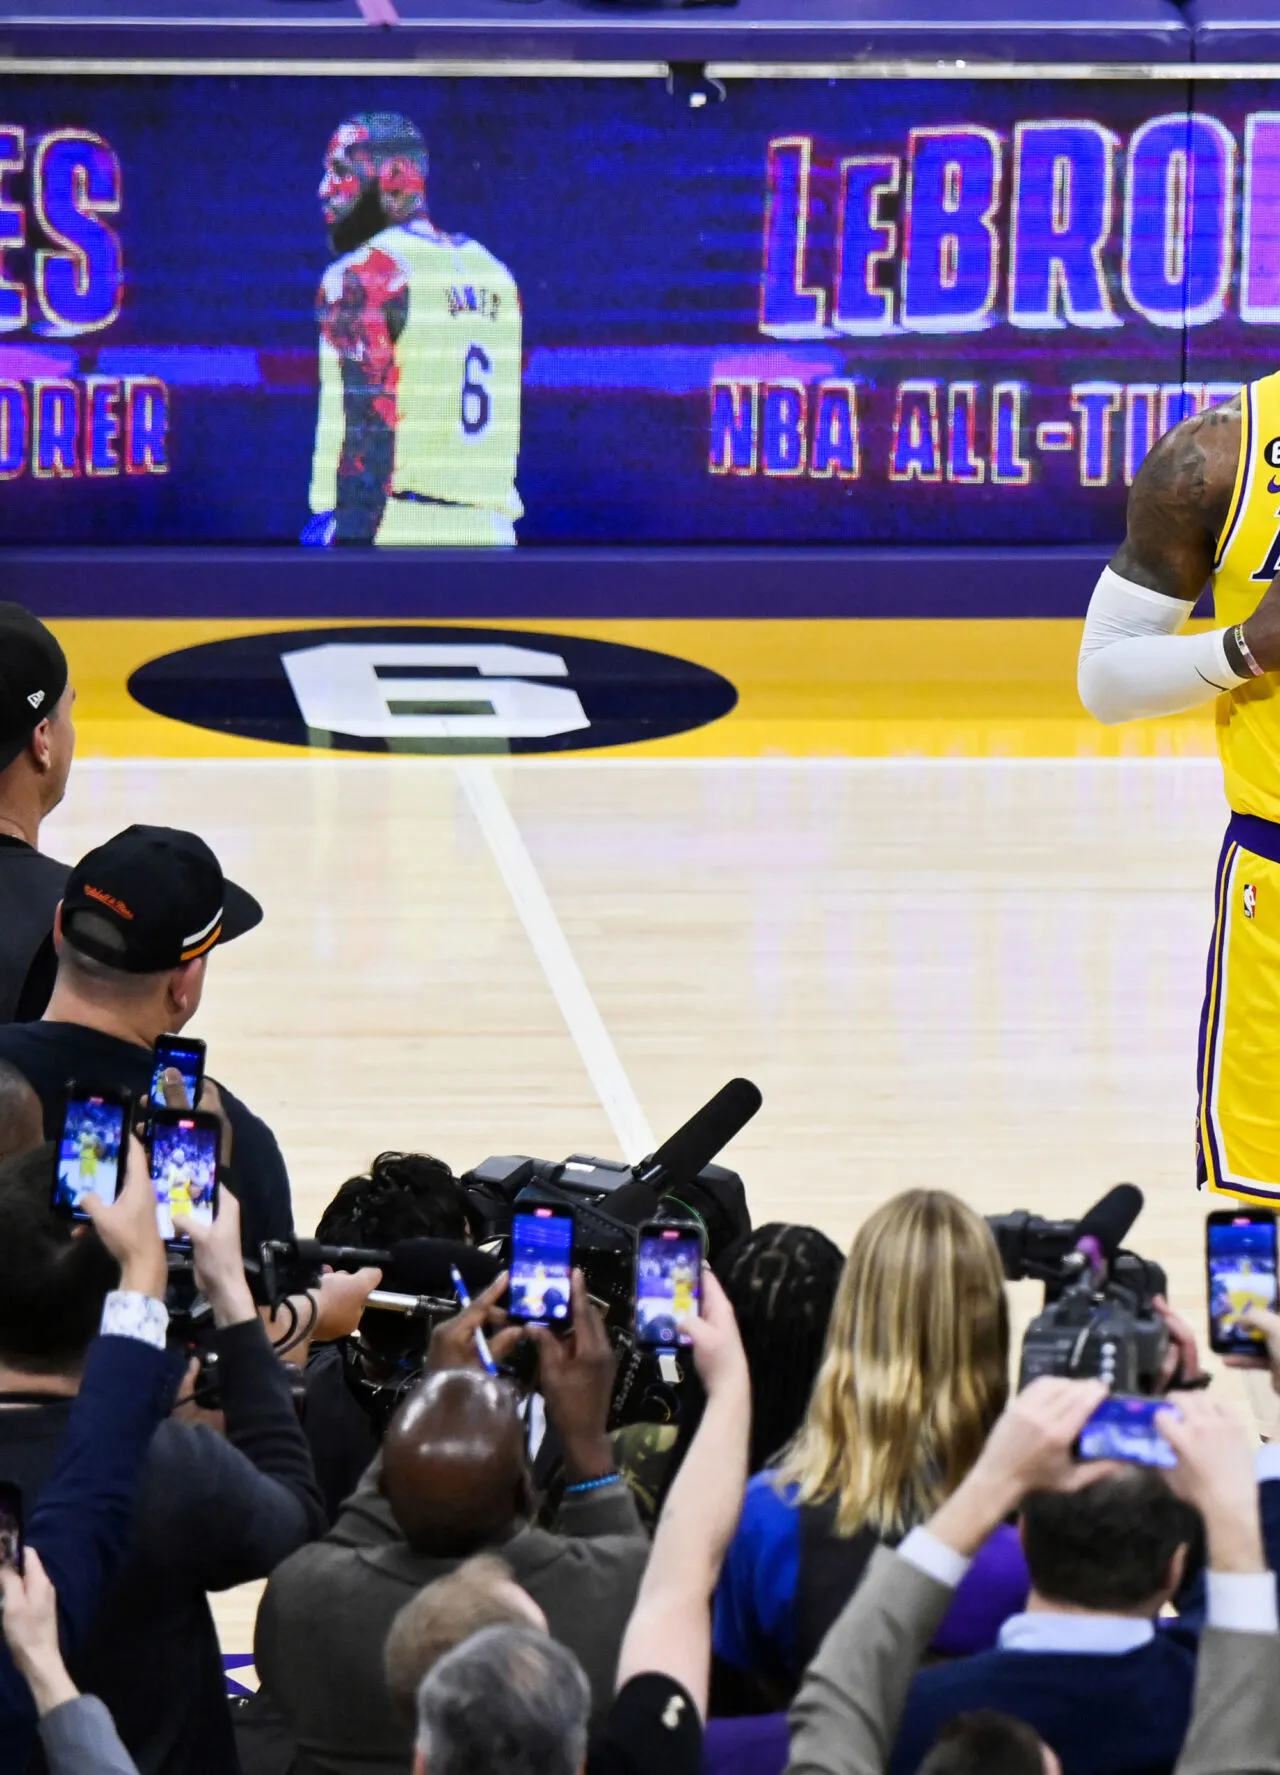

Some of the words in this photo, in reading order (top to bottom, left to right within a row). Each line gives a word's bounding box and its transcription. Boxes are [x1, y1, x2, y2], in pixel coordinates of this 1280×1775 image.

[460, 344, 491, 438] 6
[708, 379, 862, 481] NBA
[890, 381, 1243, 486] ALL-TI
[281, 643, 591, 737] 6
